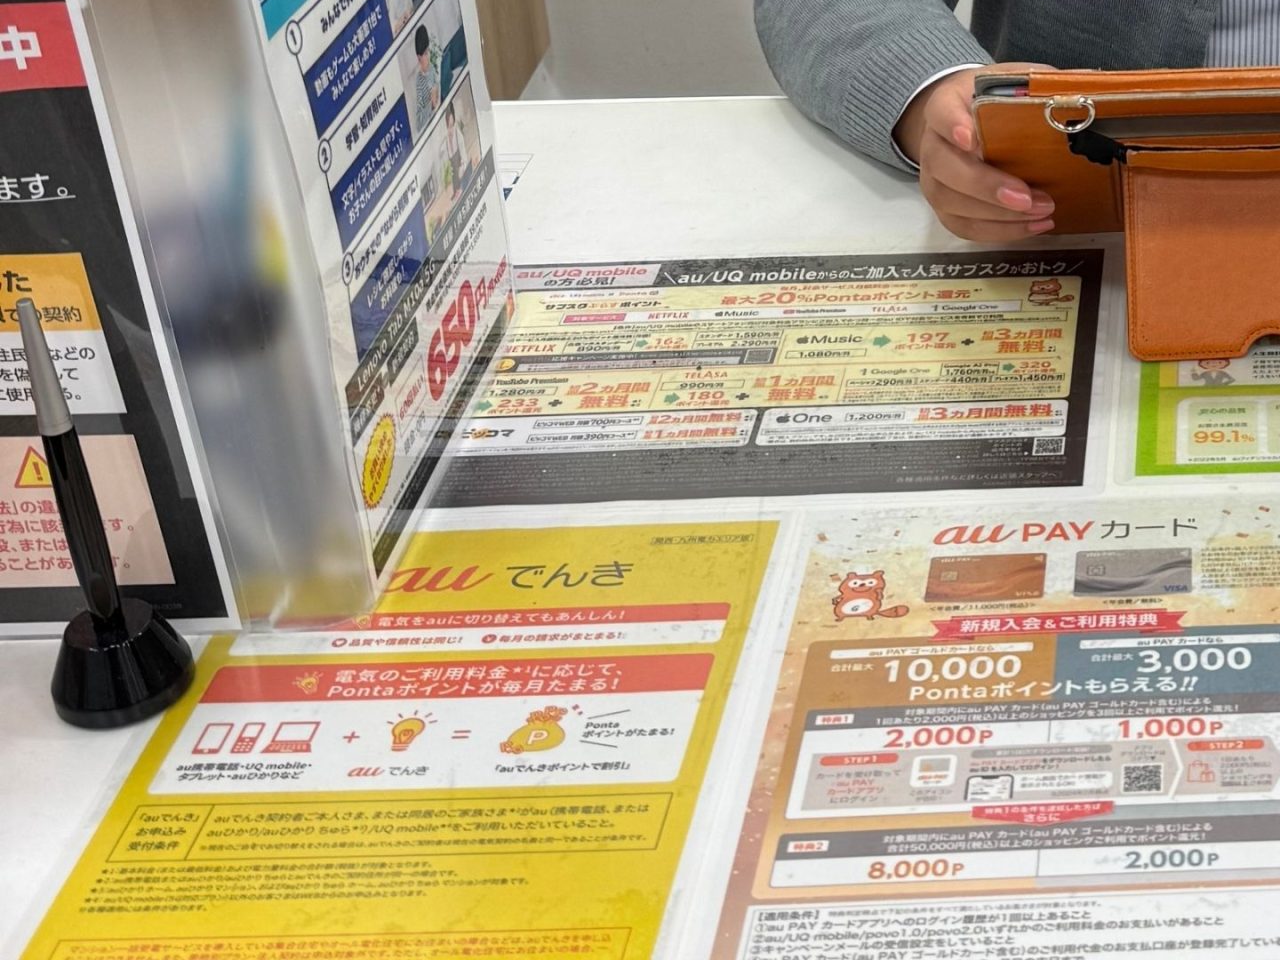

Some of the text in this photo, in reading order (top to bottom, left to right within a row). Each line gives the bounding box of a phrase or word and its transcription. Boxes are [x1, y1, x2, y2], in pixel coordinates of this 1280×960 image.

[810, 333, 863, 344] Music
[358, 340, 387, 392] Lenovo
[792, 412, 833, 424] One
[933, 518, 1199, 546] au PAY カード
[383, 560, 634, 593] au でんき
[884, 654, 1022, 683] 10,000
[1136, 646, 1253, 674] 3,000
[585, 721, 620, 730] Ponta
